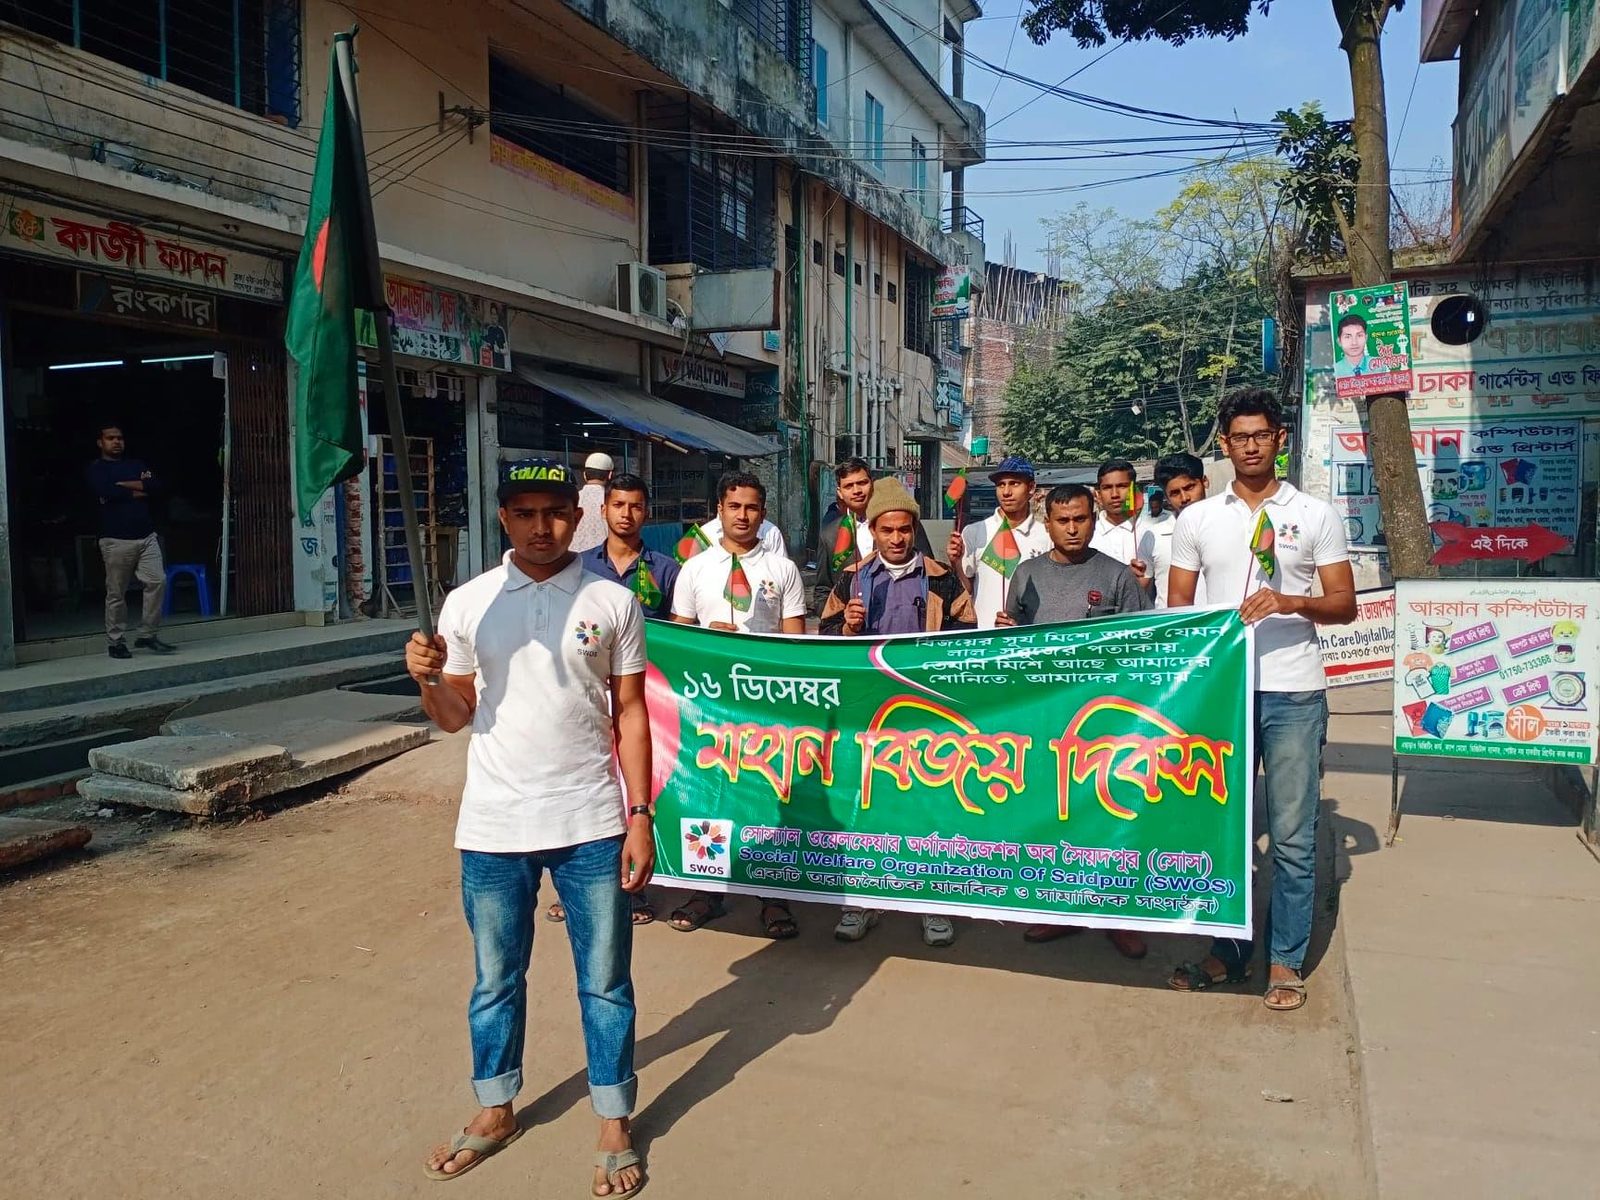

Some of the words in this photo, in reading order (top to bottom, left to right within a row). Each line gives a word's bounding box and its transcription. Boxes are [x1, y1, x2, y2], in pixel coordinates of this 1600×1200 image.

[50, 216, 148, 268] কাজী
[154, 238, 229, 284] ফ্যাশন
[686, 360, 729, 388] WALTON
[1418, 371, 1475, 393] ঢাকা
[1471, 534, 1494, 552] এই
[1496, 534, 1529, 551] দিকে
[1408, 600, 1480, 617] আরমান
[1486, 598, 1588, 619] কম্পিউটার
[915, 635, 994, 649] বিজয়ের
[1043, 630, 1091, 643] মিশে
[1331, 634, 1355, 648] Care
[1355, 629, 1382, 645] Digital
[995, 656, 1042, 671] মিশে
[1053, 656, 1109, 671] আছে
[1116, 655, 1213, 670] আমাদের
[683, 670, 721, 700] ১৬
[729, 662, 841, 710] ডিসেম্বর
[1024, 671, 1122, 685] আমাদের
[1508, 707, 1540, 740] সীল
[696, 721, 840, 804] মহান
[855, 694, 1032, 815] বিজয়
[1049, 695, 1234, 820] দিবস
[740, 824, 801, 847] সোস্যাল
[807, 829, 901, 854] ওয়েলফেয়ার
[906, 830, 1021, 862] অর্গানাইজেশন
[1026, 843, 1057, 866] অব
[1060, 839, 1140, 874] সৈয়দপুর
[1147, 848, 1213, 879] (সোস)
[690, 863, 724, 876] SWOS
[738, 848, 797, 864] Social
[803, 851, 876, 870] Welfare
[880, 858, 1014, 880] Organization
[1019, 866, 1046, 882] Of
[1051, 868, 1138, 890] Saidpur
[1144, 874, 1236, 898] (SWOS)
[746, 865, 801, 882] (একটি
[807, 871, 924, 892] অরাজনৈতিক
[931, 879, 1008, 899] মানবিক
[1015, 888, 1029, 900] ও
[1036, 887, 1129, 908] সামাজিক
